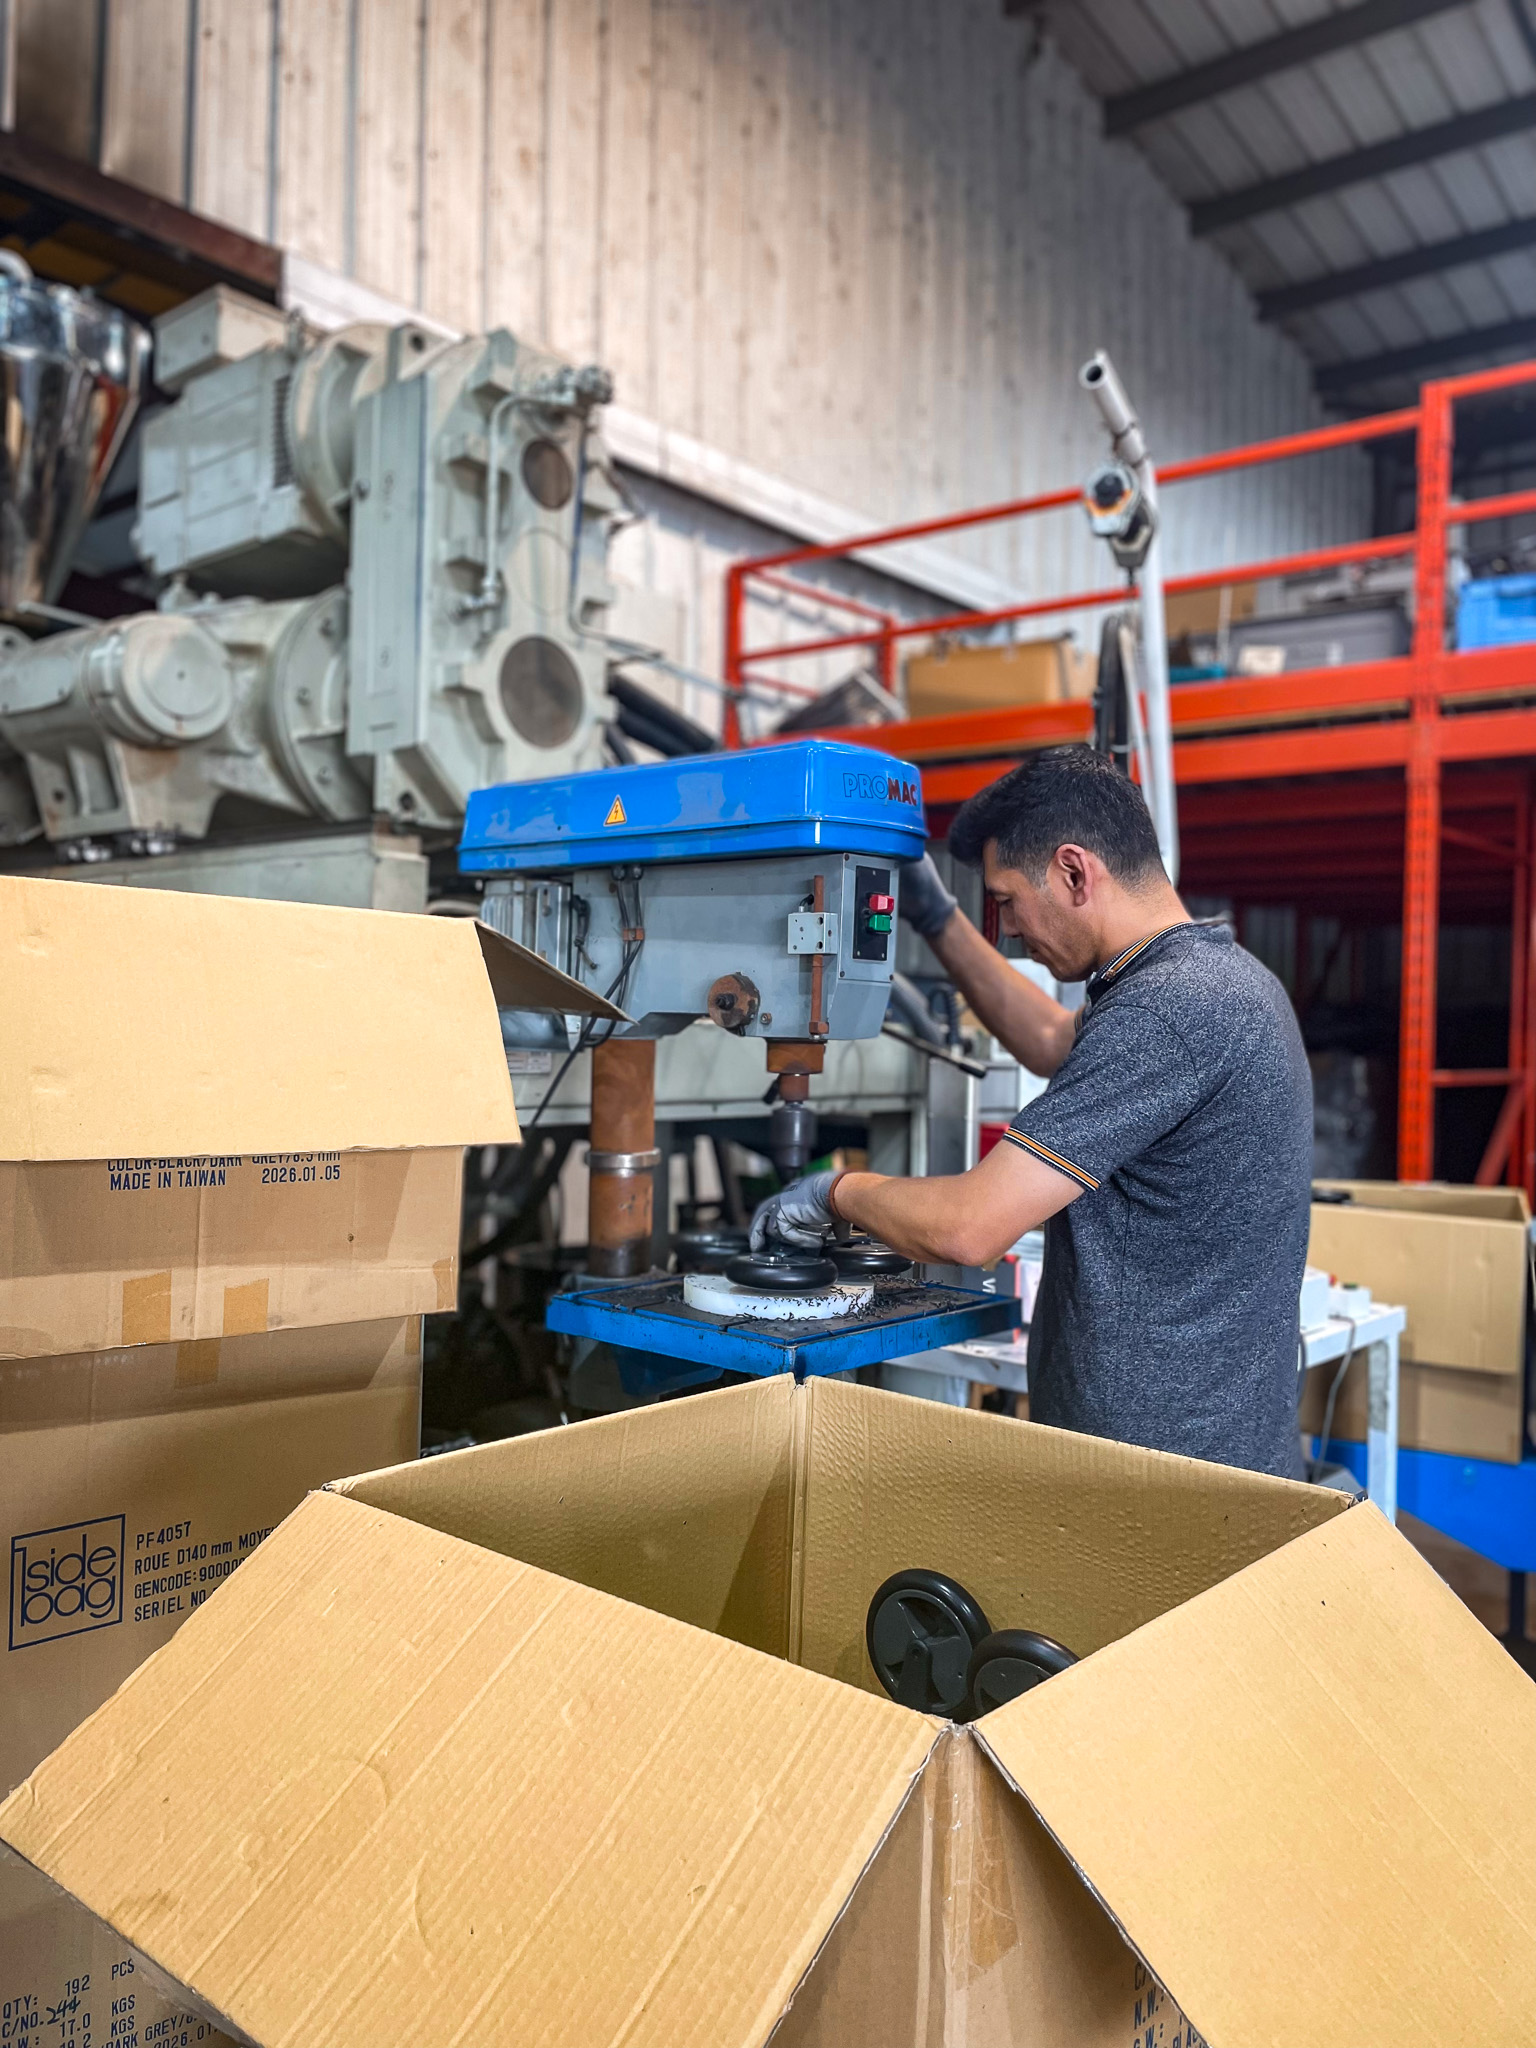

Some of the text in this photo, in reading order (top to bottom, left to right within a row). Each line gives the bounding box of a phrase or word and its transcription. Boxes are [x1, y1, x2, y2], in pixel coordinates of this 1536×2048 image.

[842, 772, 917, 806] PROMAC
[110, 1169, 226, 1191] MADE IN TAIWAN
[261, 1164, 340, 1184] 2026.01.05
[136, 1520, 191, 1551] PF4057
[134, 1526, 274, 1576] ROUE D140 mm MOYE
[134, 1595, 185, 1622] SERIEL
[3, 1958, 135, 2019] QTY: 192 PCS
[2, 2011, 44, 2038] C/NO.
[60, 1994, 136, 2038] 17.0 KGS
[110, 2014, 135, 2038] KGS
